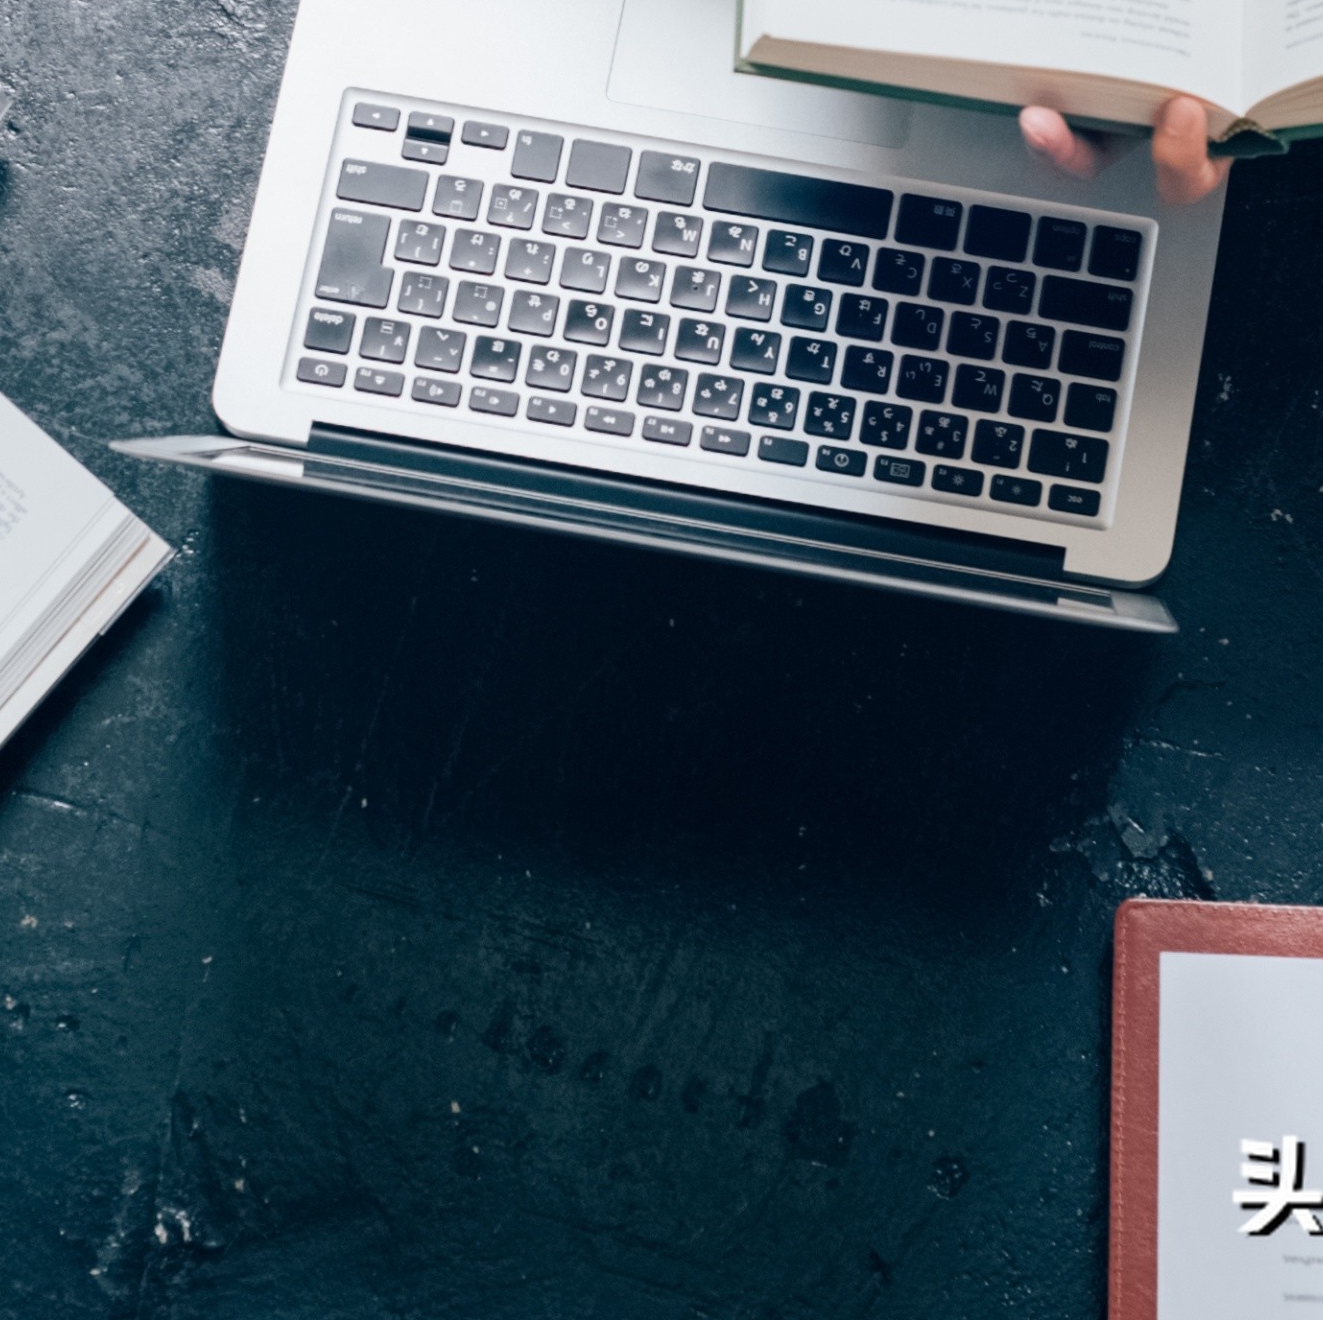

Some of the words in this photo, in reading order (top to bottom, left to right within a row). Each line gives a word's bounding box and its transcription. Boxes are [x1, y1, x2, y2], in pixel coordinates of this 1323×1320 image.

[345, 163, 367, 175] shift
[670, 159, 696, 174] かな
[334, 212, 363, 224] return
[682, 229, 698, 243] M
[739, 238, 753, 252] N
[798, 248, 808, 261] B
[850, 257, 862, 270] V
[597, 265, 605, 279] L
[907, 266, 918, 279] C
[648, 274, 661, 288] K
[962, 276, 973, 289] X
[705, 283, 715, 297] J
[1018, 285, 1029, 298] Z
[758, 293, 771, 307] H
[541, 309, 553, 322] P
[814, 302, 826, 316] G
[313, 311, 344, 326] delete
[873, 313, 882, 325] F
[926, 321, 938, 334] D
[706, 336, 720, 350] U
[984, 331, 993, 344] S
[763, 346, 775, 360] Y
[1038, 340, 1049, 353] A
[821, 356, 830, 369] T
[877, 365, 887, 378] R
[616, 373, 626, 387] 9
[934, 374, 943, 387] E
[672, 382, 682, 396] 8
[983, 383, 997, 396] W
[727, 392, 738, 406] 7
[1042, 393, 1054, 406] Q
[784, 401, 794, 414] 6
[840, 411, 850, 424] 5
[896, 421, 905, 433] 4
[952, 430, 961, 442] 3
[1008, 439, 1018, 452] 2
[1067, 494, 1083, 504] esc
